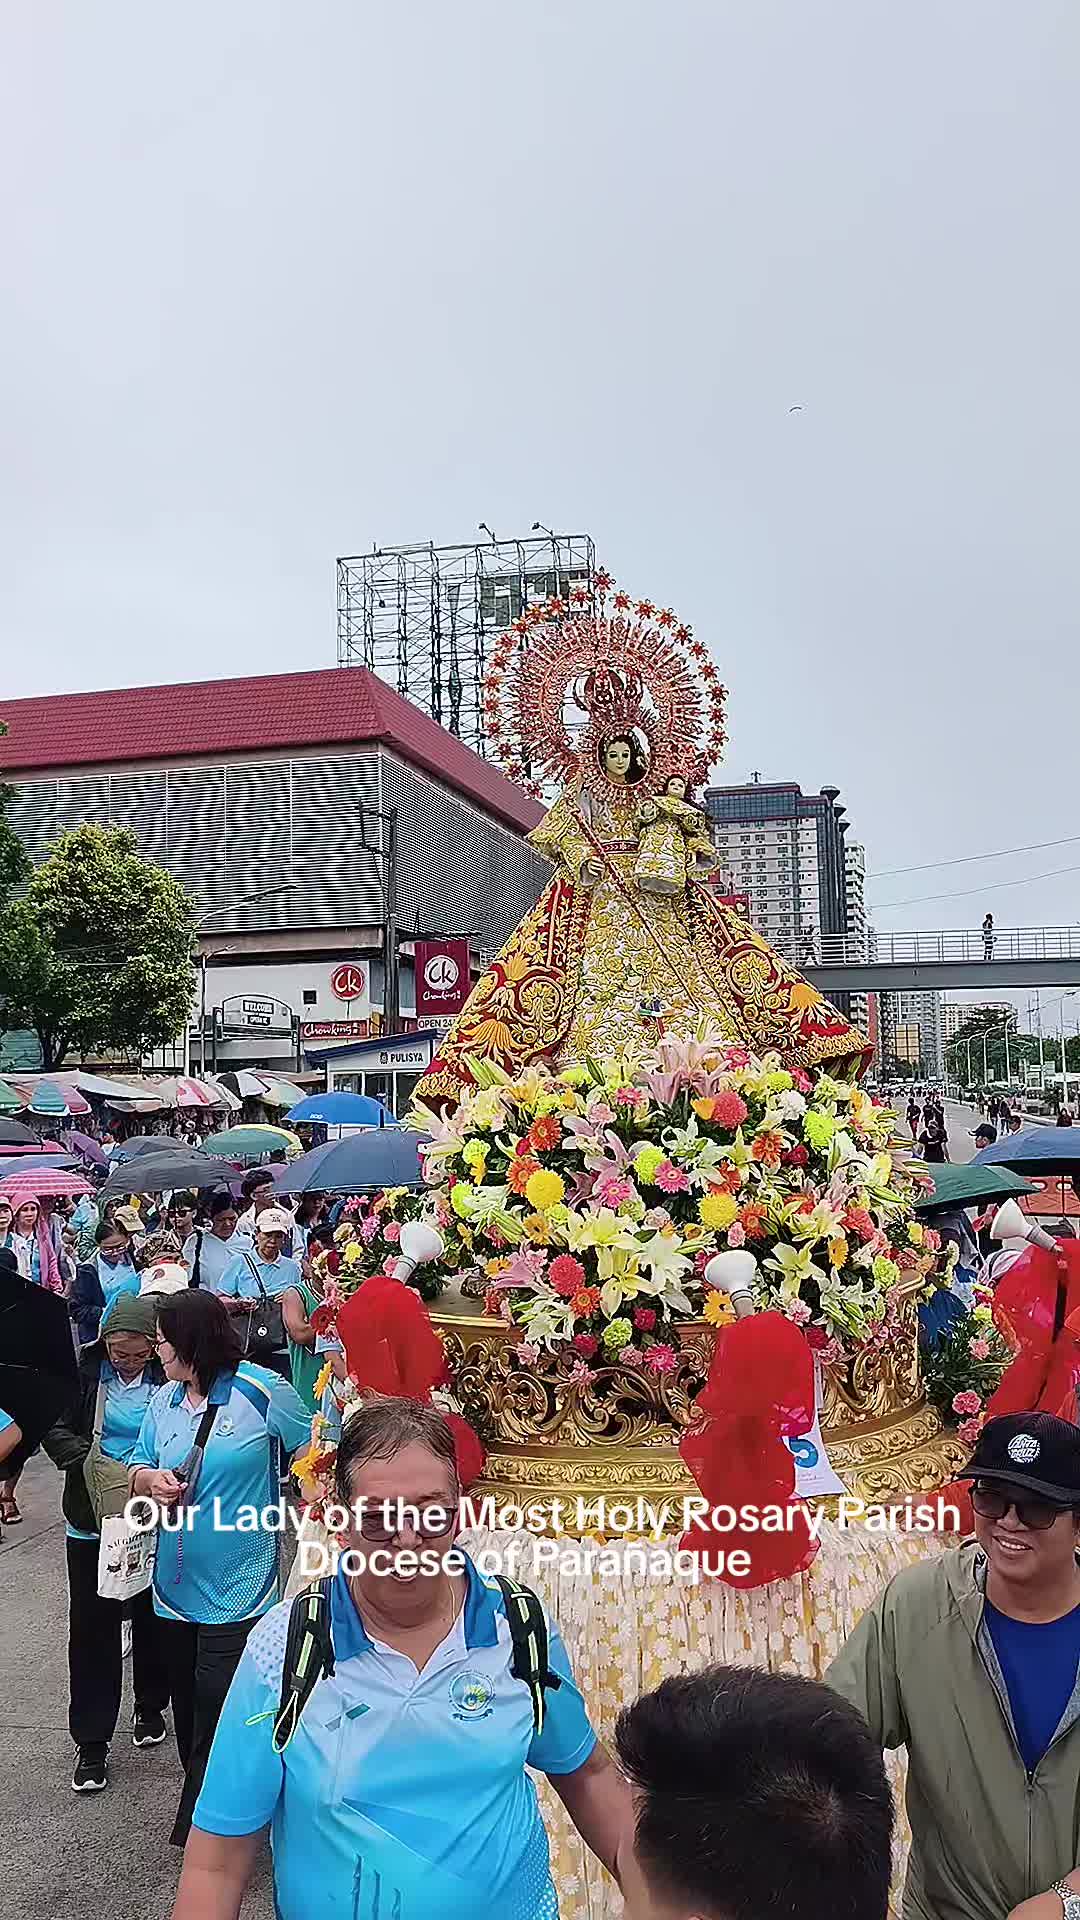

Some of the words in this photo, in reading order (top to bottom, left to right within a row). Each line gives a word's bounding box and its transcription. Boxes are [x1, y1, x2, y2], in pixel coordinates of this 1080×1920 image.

[335, 969, 361, 993] Ck
[418, 1019, 441, 1029] OPEN
[303, 1023, 352, 1038] Chowking
[390, 1053, 423, 1063] PULISYA
